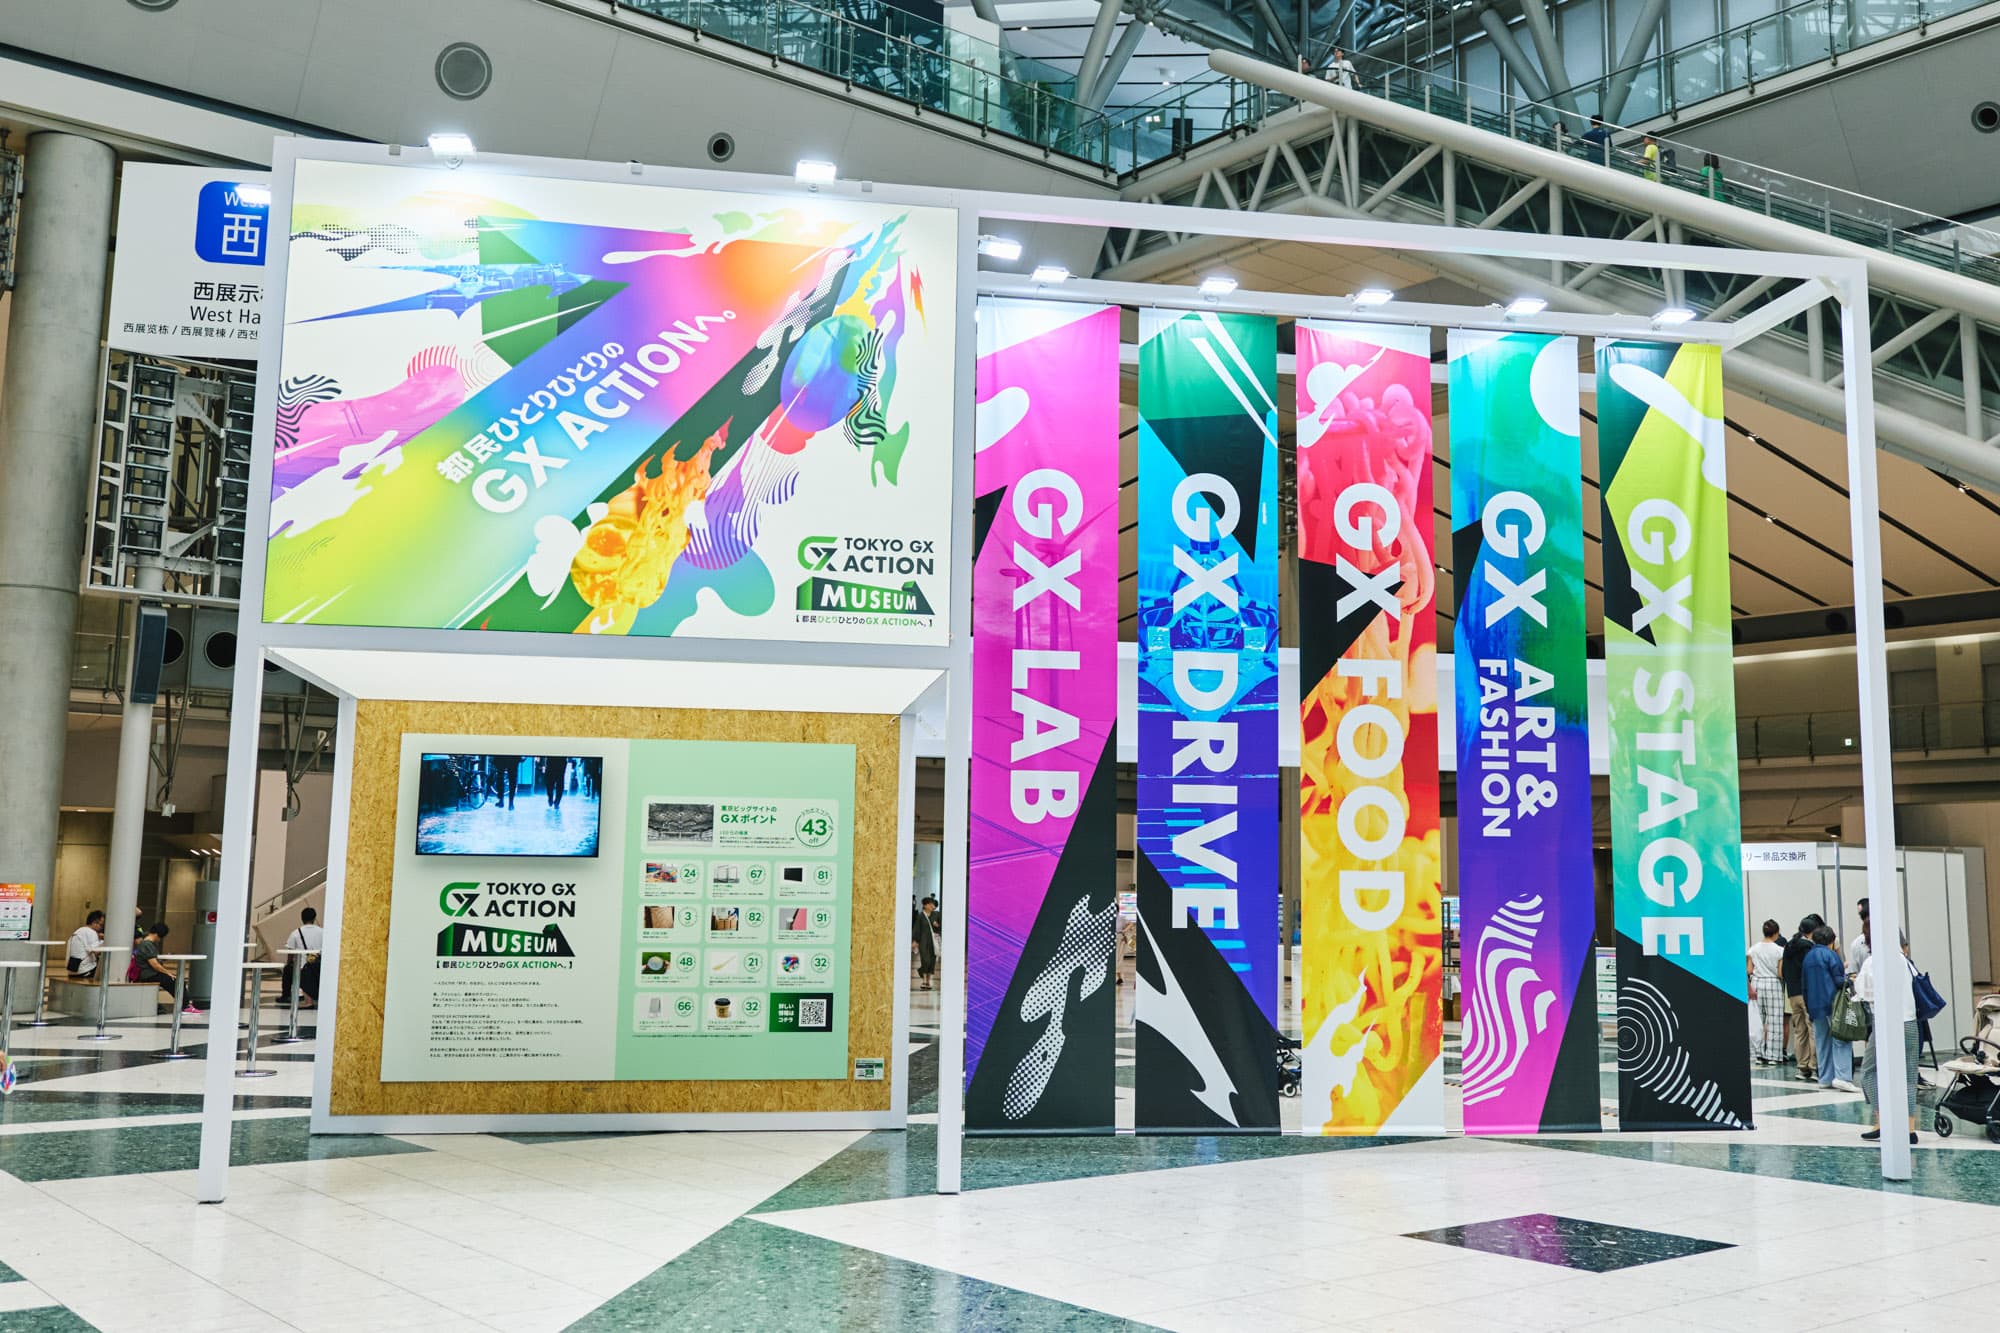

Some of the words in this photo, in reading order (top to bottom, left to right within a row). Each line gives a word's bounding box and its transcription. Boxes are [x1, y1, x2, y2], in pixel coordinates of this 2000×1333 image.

[222, 213, 262, 257] 西
[193, 281, 264, 303] 西展示
[190, 305, 232, 323] West
[436, 342, 625, 484] 都民ひとりひとりの
[471, 435, 570, 513] GX
[844, 537, 903, 552] TOKYO
[909, 540, 934, 553] GX
[1012, 468, 1084, 612] GX
[1171, 472, 1241, 614] GX
[1333, 482, 1401, 623] GX
[1481, 490, 1548, 629] GX
[843, 555, 934, 575] ACTION
[1626, 498, 1693, 634] GX
[820, 583, 917, 611] MUSEUM
[1010, 648, 1081, 824] LAB
[1479, 658, 1511, 838] FASHION
[1171, 651, 1240, 930] DRIVE
[1336, 657, 1406, 931] FOOD
[1632, 666, 1705, 957] STAGE
[802, 818, 827, 836] 43
[1742, 851, 1807, 862] リー景品交換所
[683, 869, 696, 878] 24
[750, 869, 763, 879] 67
[817, 871, 829, 880] 81
[486, 882, 545, 896] TOKYO
[552, 883, 576, 896] GX
[484, 900, 576, 917] ACTION
[685, 912, 692, 921] 3
[748, 912, 761, 922] 82
[816, 912, 827, 922] 91
[461, 929, 557, 953] MUSEUM
[679, 957, 693, 966] 48
[749, 958, 759, 967] 21
[814, 958, 827, 967] 32
[677, 1001, 692, 1011] 66
[745, 1001, 758, 1011] 32
